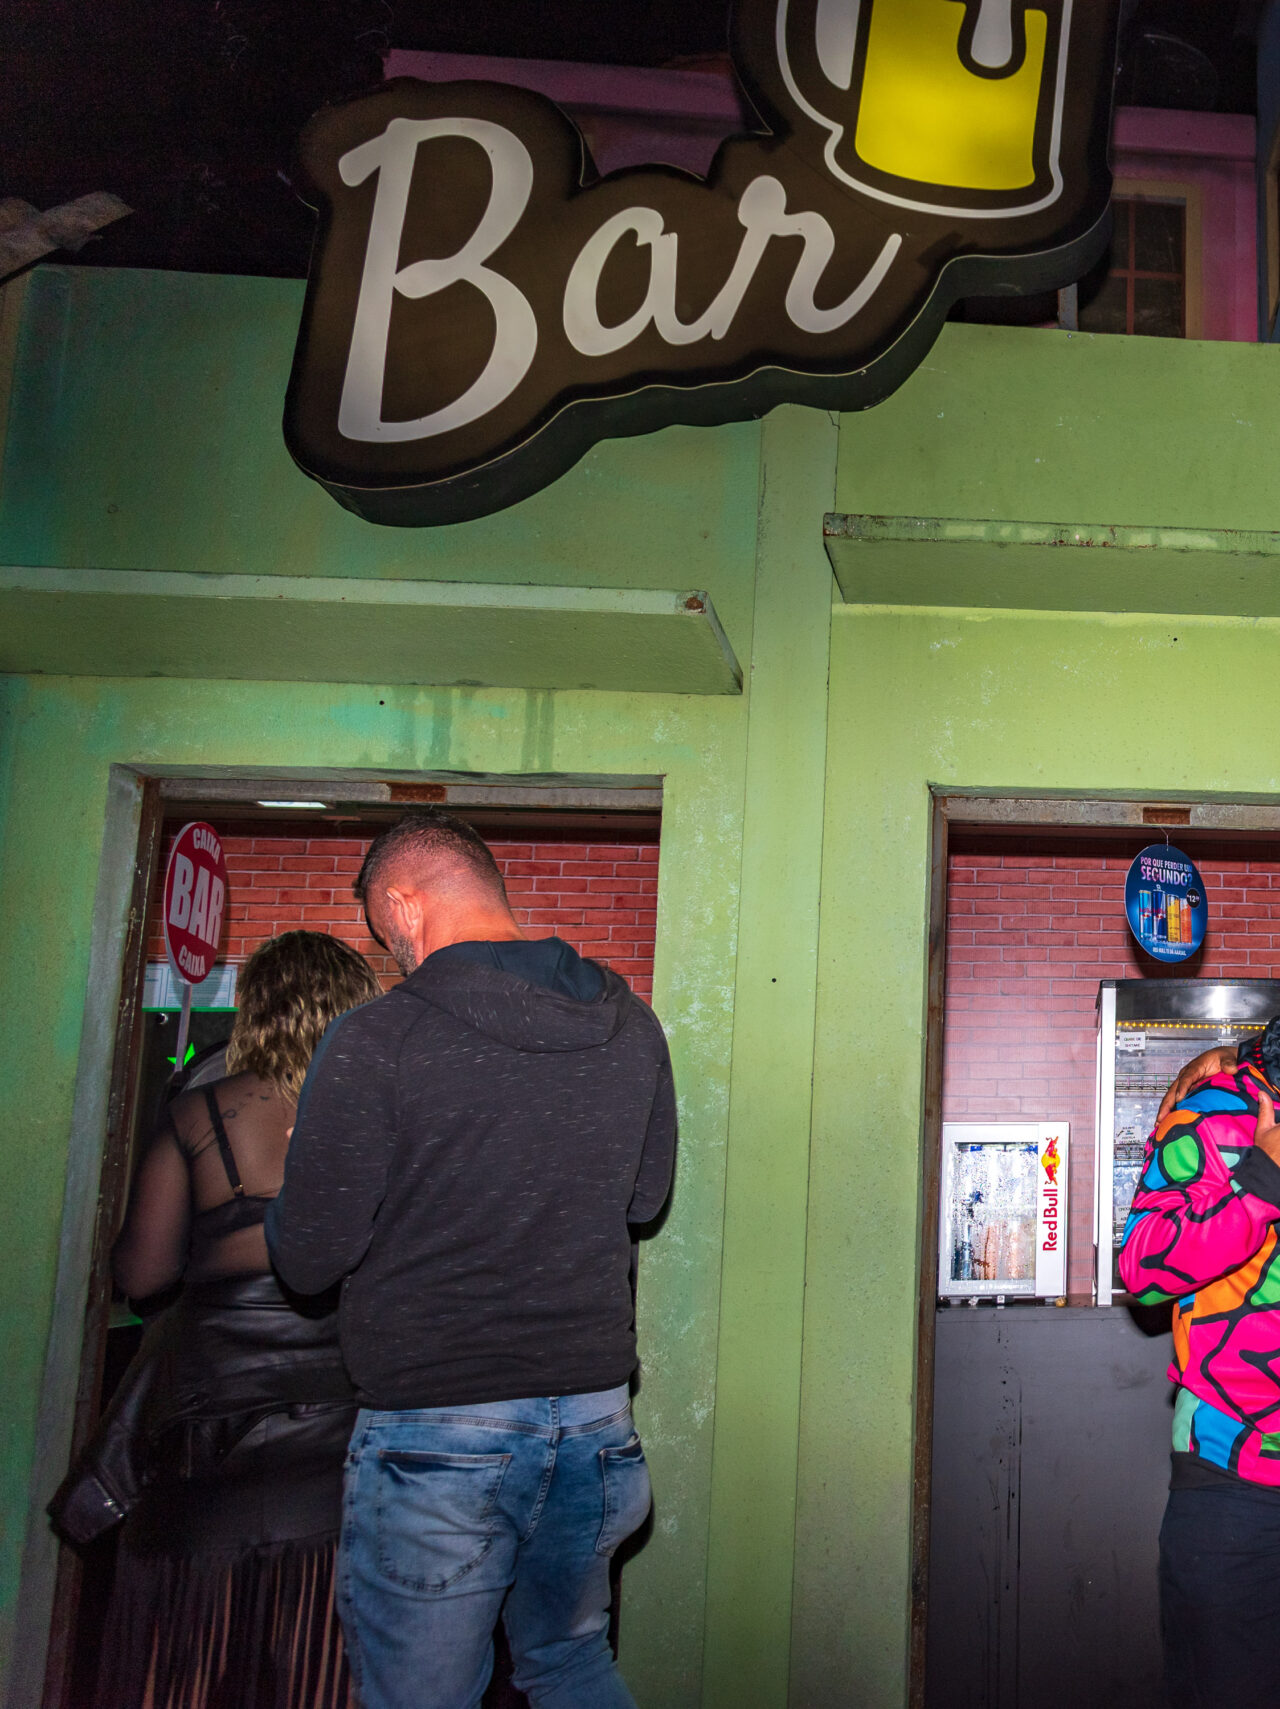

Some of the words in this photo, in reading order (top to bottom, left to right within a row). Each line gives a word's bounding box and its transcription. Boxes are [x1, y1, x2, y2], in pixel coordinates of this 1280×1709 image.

[337, 117, 902, 442] Bar
[192, 828, 222, 864] CAIXA
[1140, 856, 1152, 866] POR
[1152, 858, 1164, 868] QUE
[1164, 860, 1184, 870] PERDER
[1141, 865, 1193, 887] SEGUNDO?
[169, 852, 225, 949] BAR
[178, 944, 206, 976] CAIXA
[1042, 1188, 1058, 1218] Bull
[1042, 1220, 1058, 1251] Red
